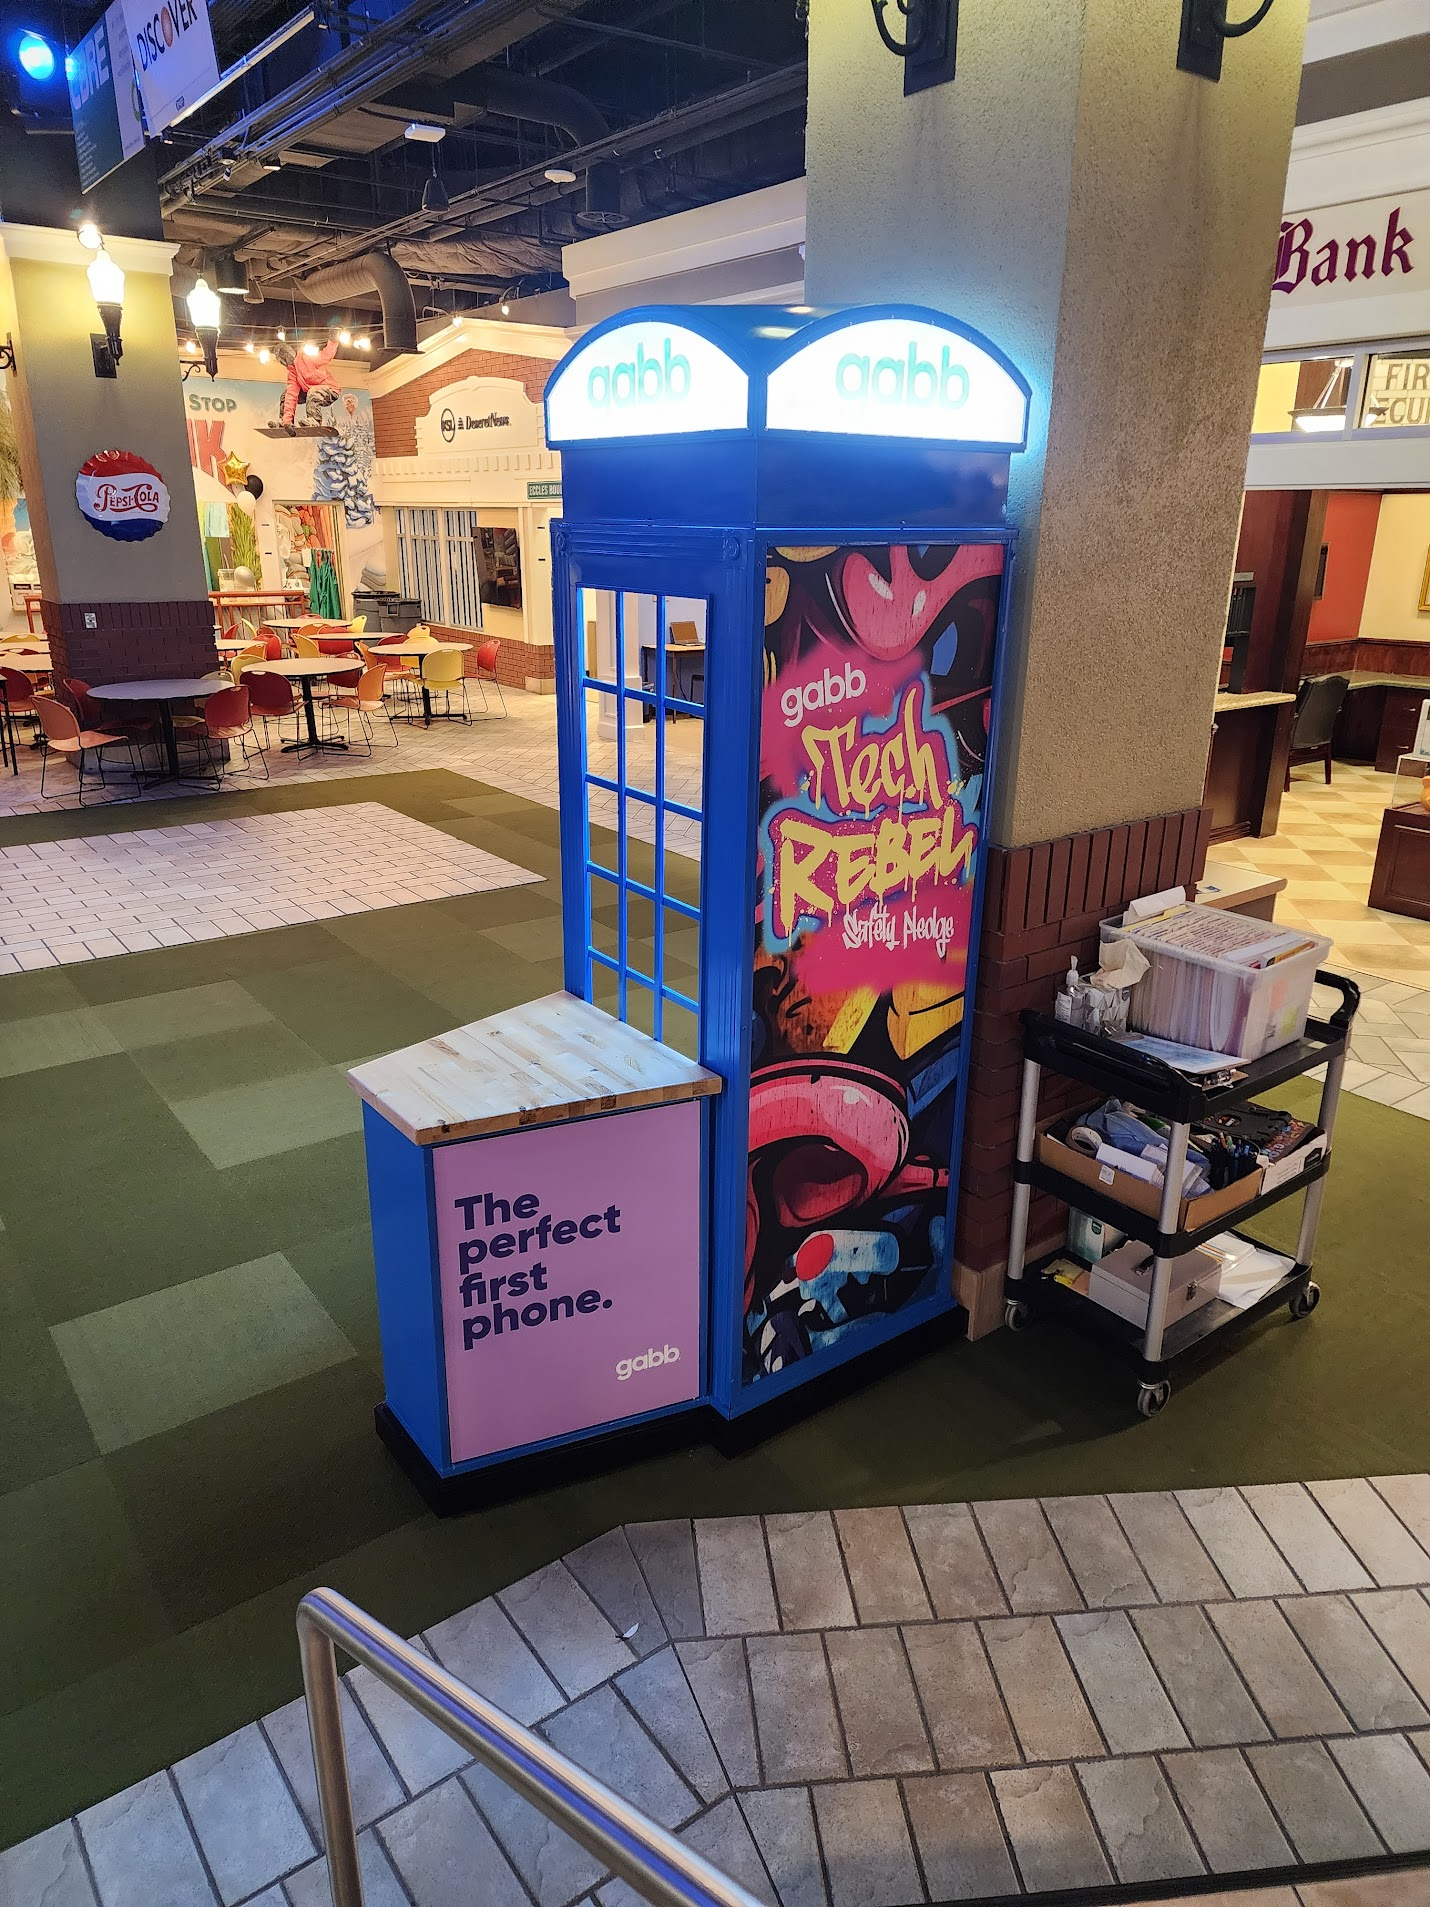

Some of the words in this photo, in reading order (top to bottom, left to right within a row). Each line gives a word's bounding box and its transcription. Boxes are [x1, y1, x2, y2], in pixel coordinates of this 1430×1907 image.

[136, 0, 198, 71] DISCOVER
[1271, 207, 1414, 294] Bank
[189, 394, 237, 412] STOP
[529, 485, 549, 496] ECCLES
[781, 662, 867, 727] gabb
[801, 687, 944, 814] Tech
[779, 806, 974, 938] REBEL
[842, 902, 899, 951] Safety
[903, 906, 955, 959] Pledge
[454, 1192, 540, 1231] The
[458, 1204, 621, 1275] perfect
[459, 1261, 548, 1308] first
[462, 1289, 613, 1351] phone.
[615, 1344, 681, 1381] gabb
